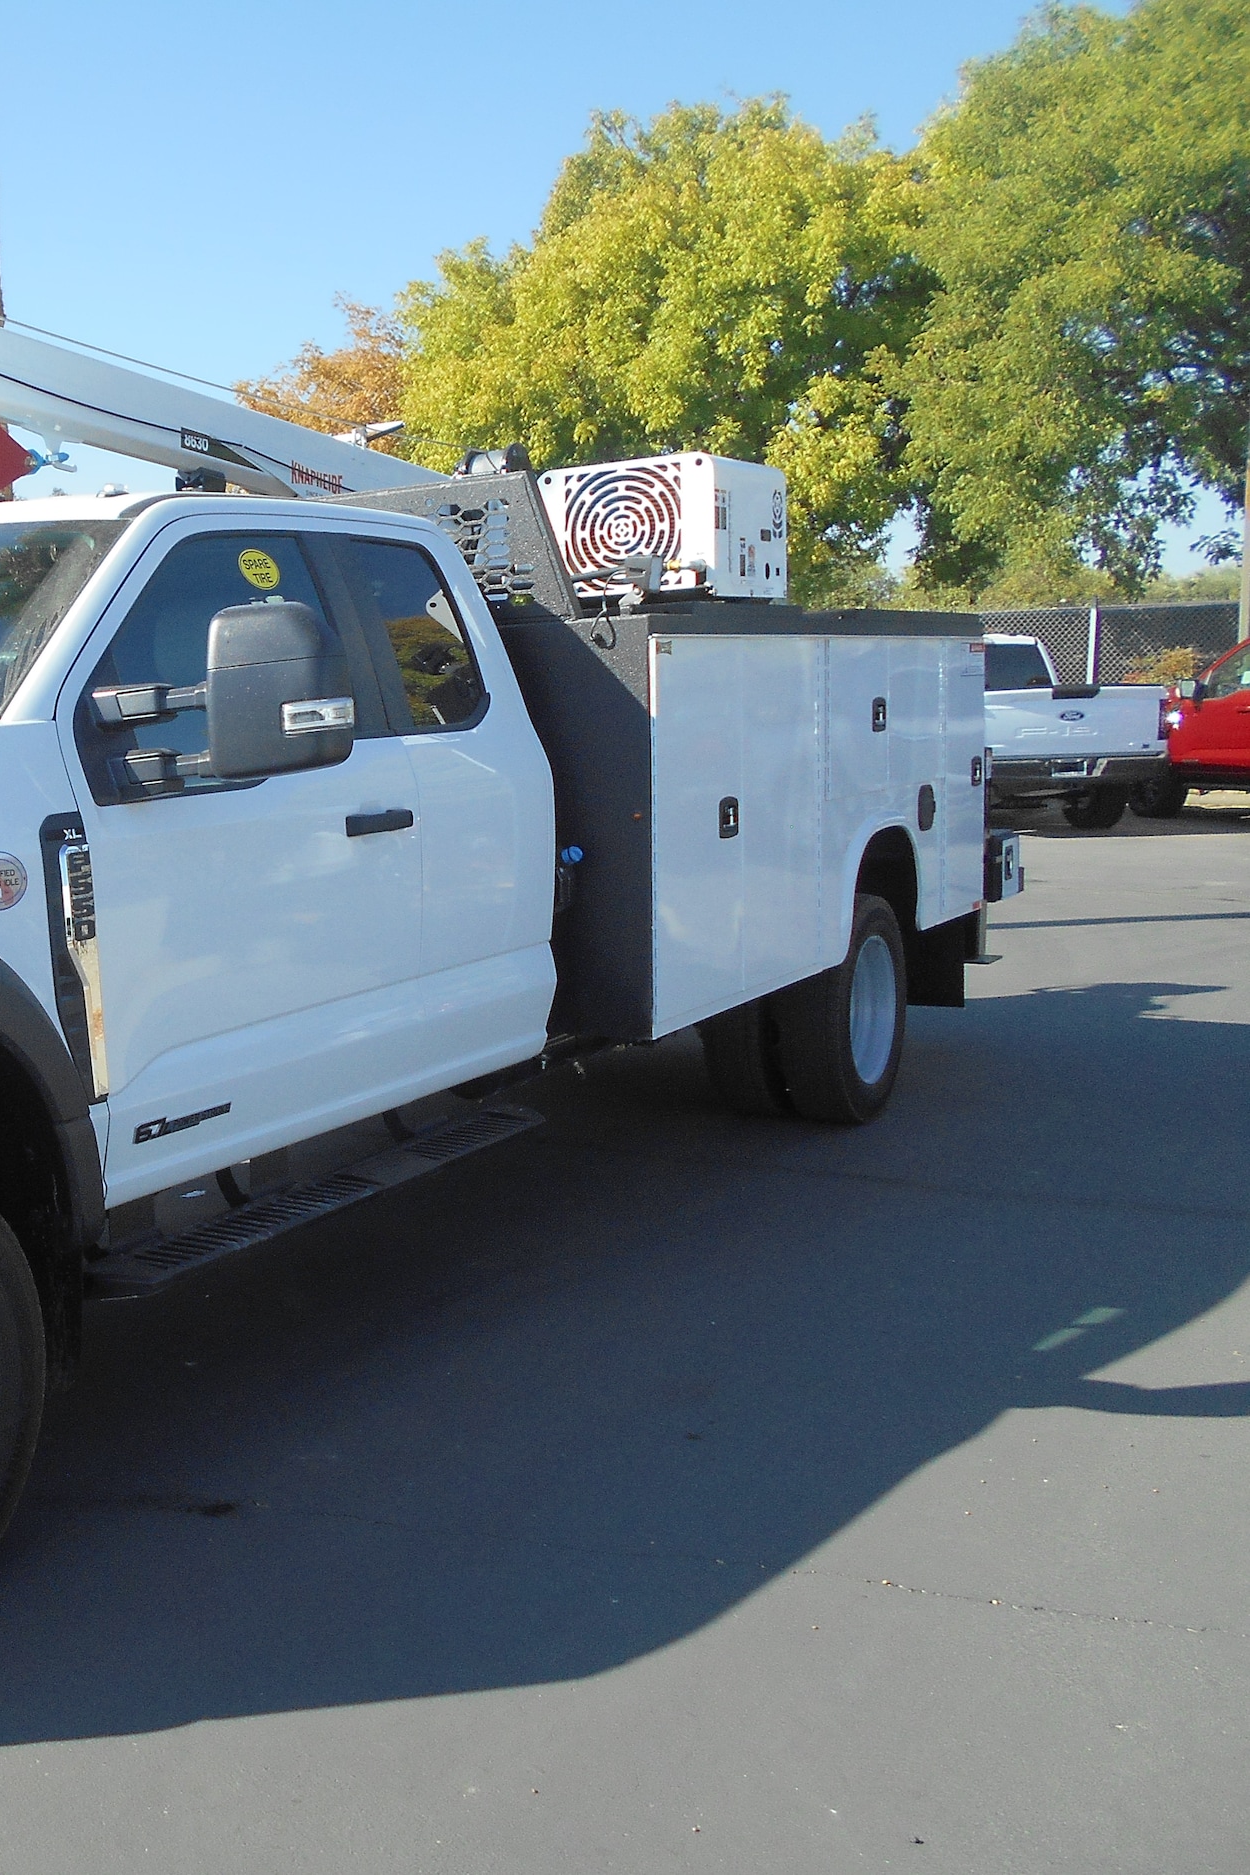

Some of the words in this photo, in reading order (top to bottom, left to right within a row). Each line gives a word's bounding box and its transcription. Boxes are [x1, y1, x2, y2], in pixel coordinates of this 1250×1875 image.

[291, 460, 343, 494] KNAPHEIDE
[242, 558, 271, 570] SPARE
[252, 572, 273, 584] TIRE
[63, 828, 82, 840] XL
[3, 877, 20, 887] IDLE
